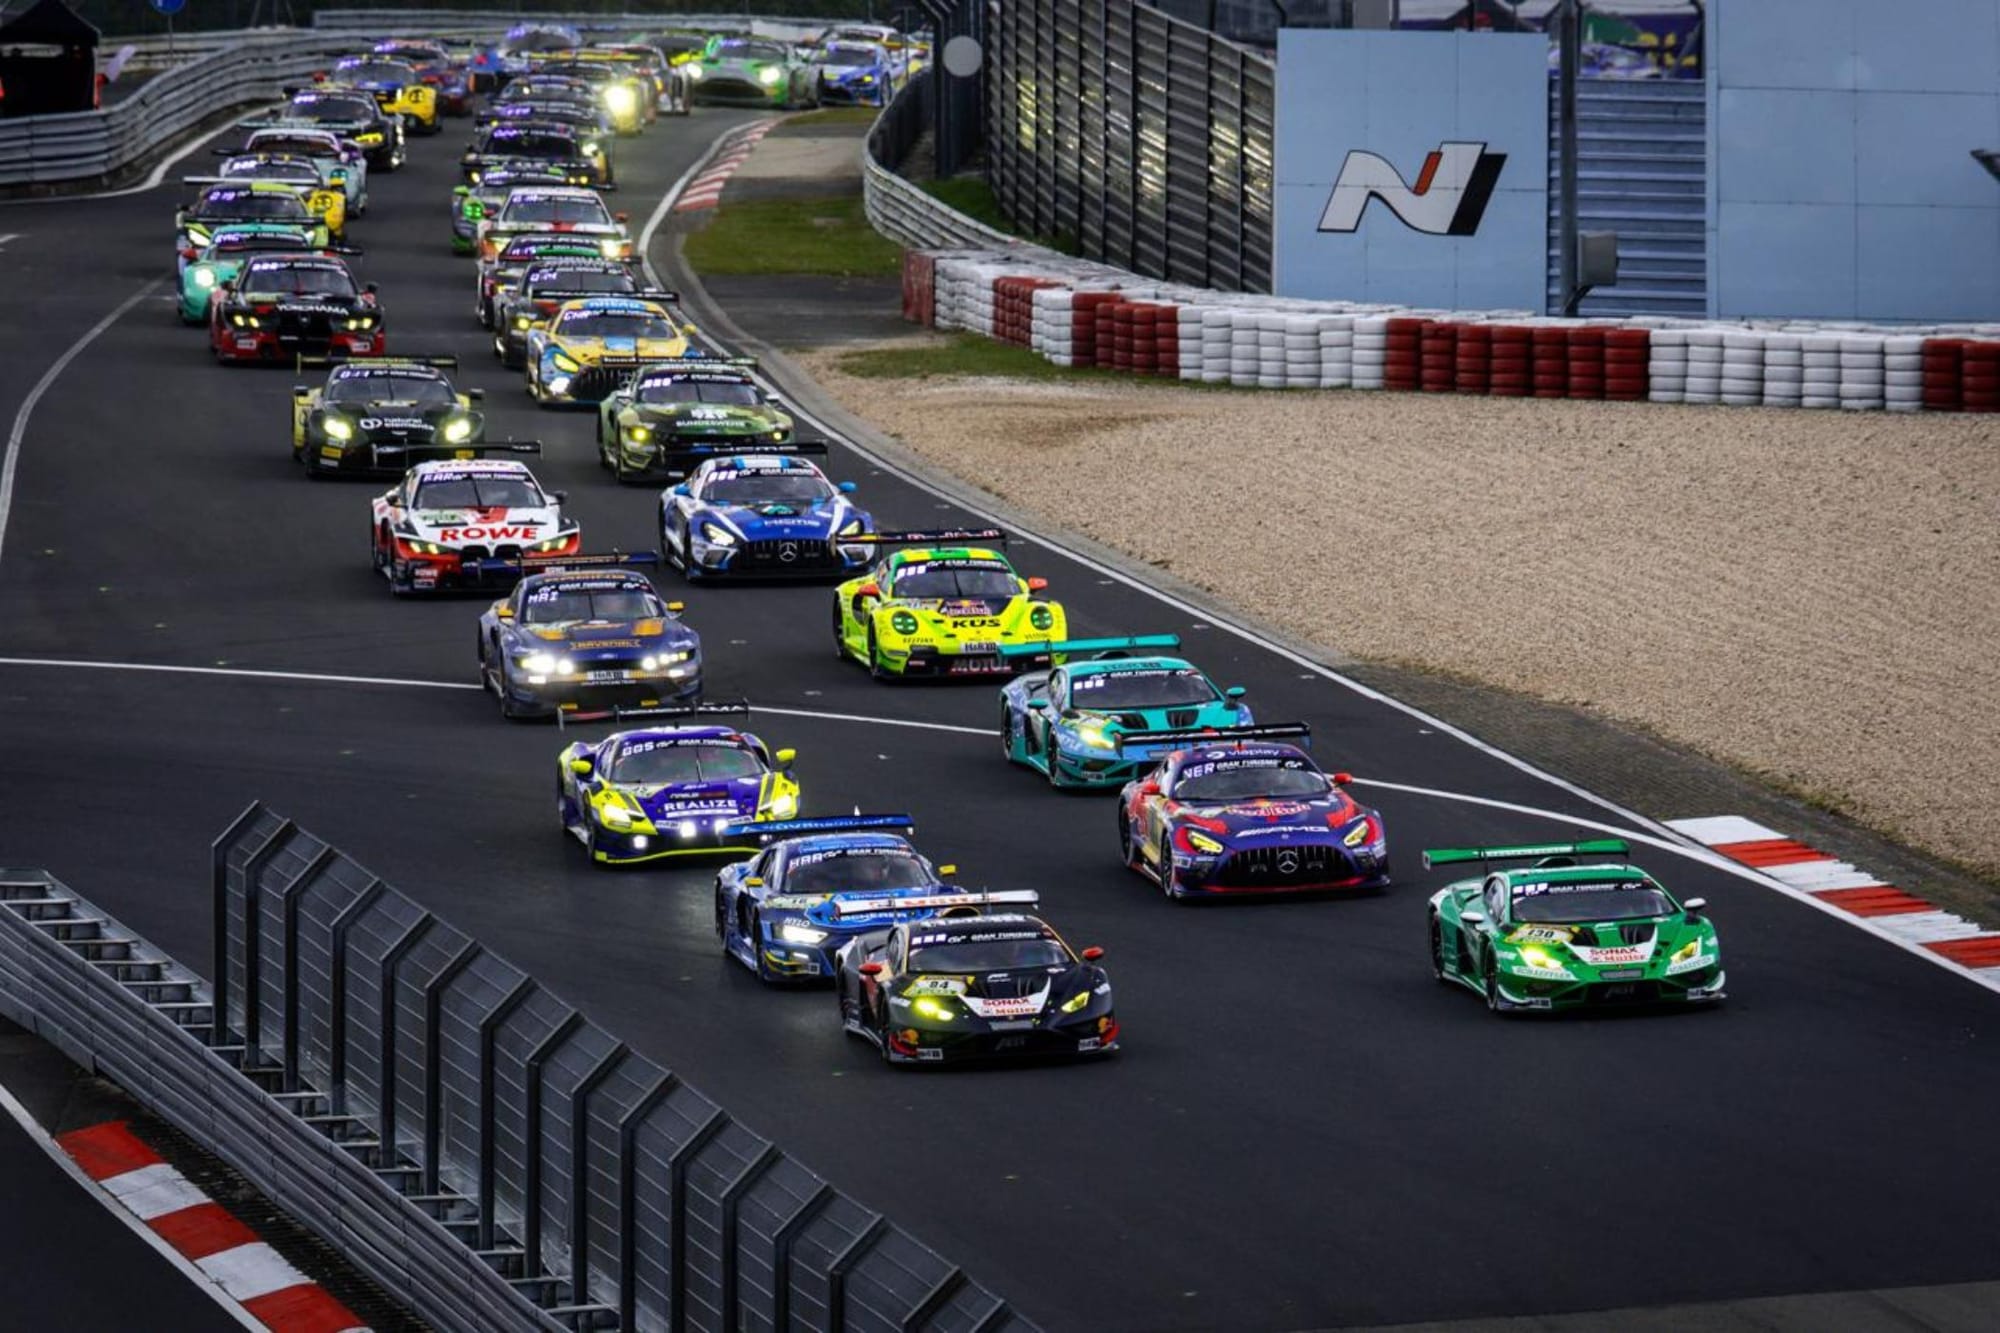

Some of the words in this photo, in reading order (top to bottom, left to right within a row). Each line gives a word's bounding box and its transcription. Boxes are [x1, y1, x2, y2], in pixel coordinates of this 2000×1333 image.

[440, 527, 538, 542] ROWE
[663, 800, 738, 812] REALIZE
[1589, 946, 1639, 957] SONAX
[983, 998, 1030, 1007] SONAX
